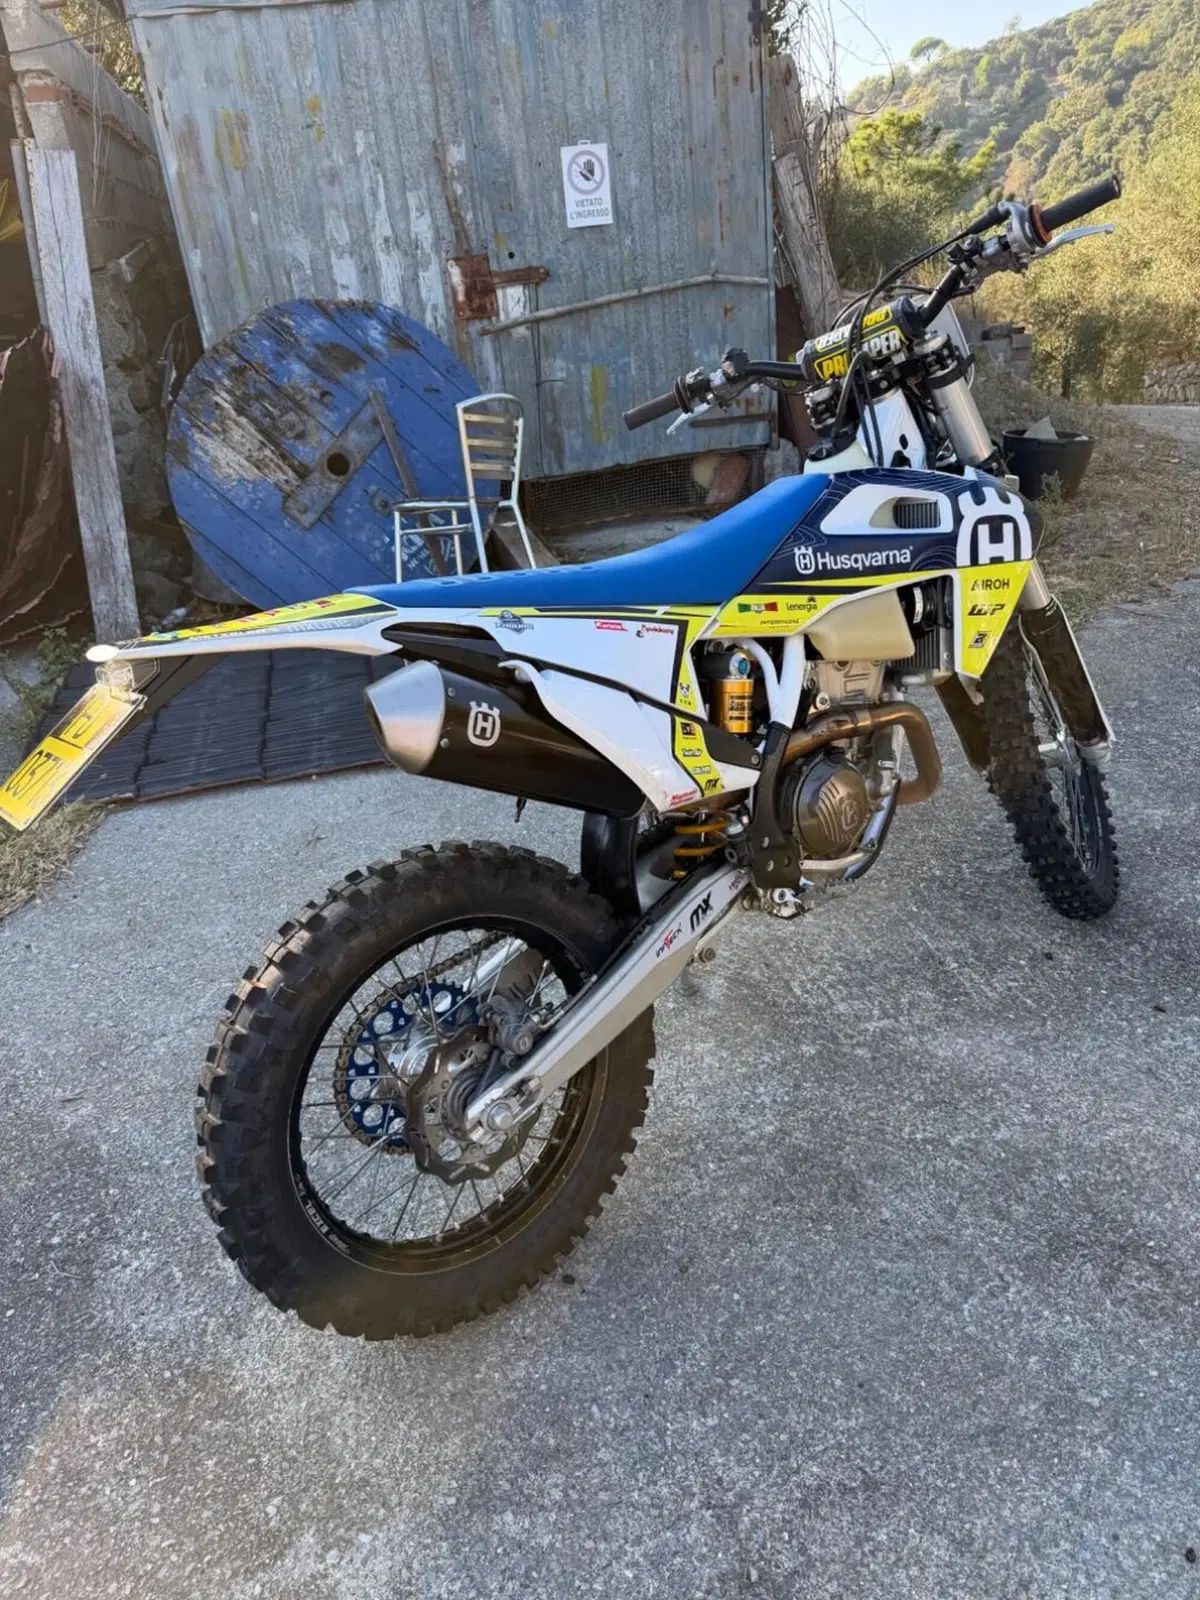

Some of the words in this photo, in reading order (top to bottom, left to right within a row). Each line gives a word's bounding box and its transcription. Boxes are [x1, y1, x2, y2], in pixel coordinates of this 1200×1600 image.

[575, 197, 603, 208] VIETATO
[570, 207, 609, 220] L'INGRESSO
[817, 549, 911, 571] Husqvarna
[971, 578, 1010, 592] AIROH
